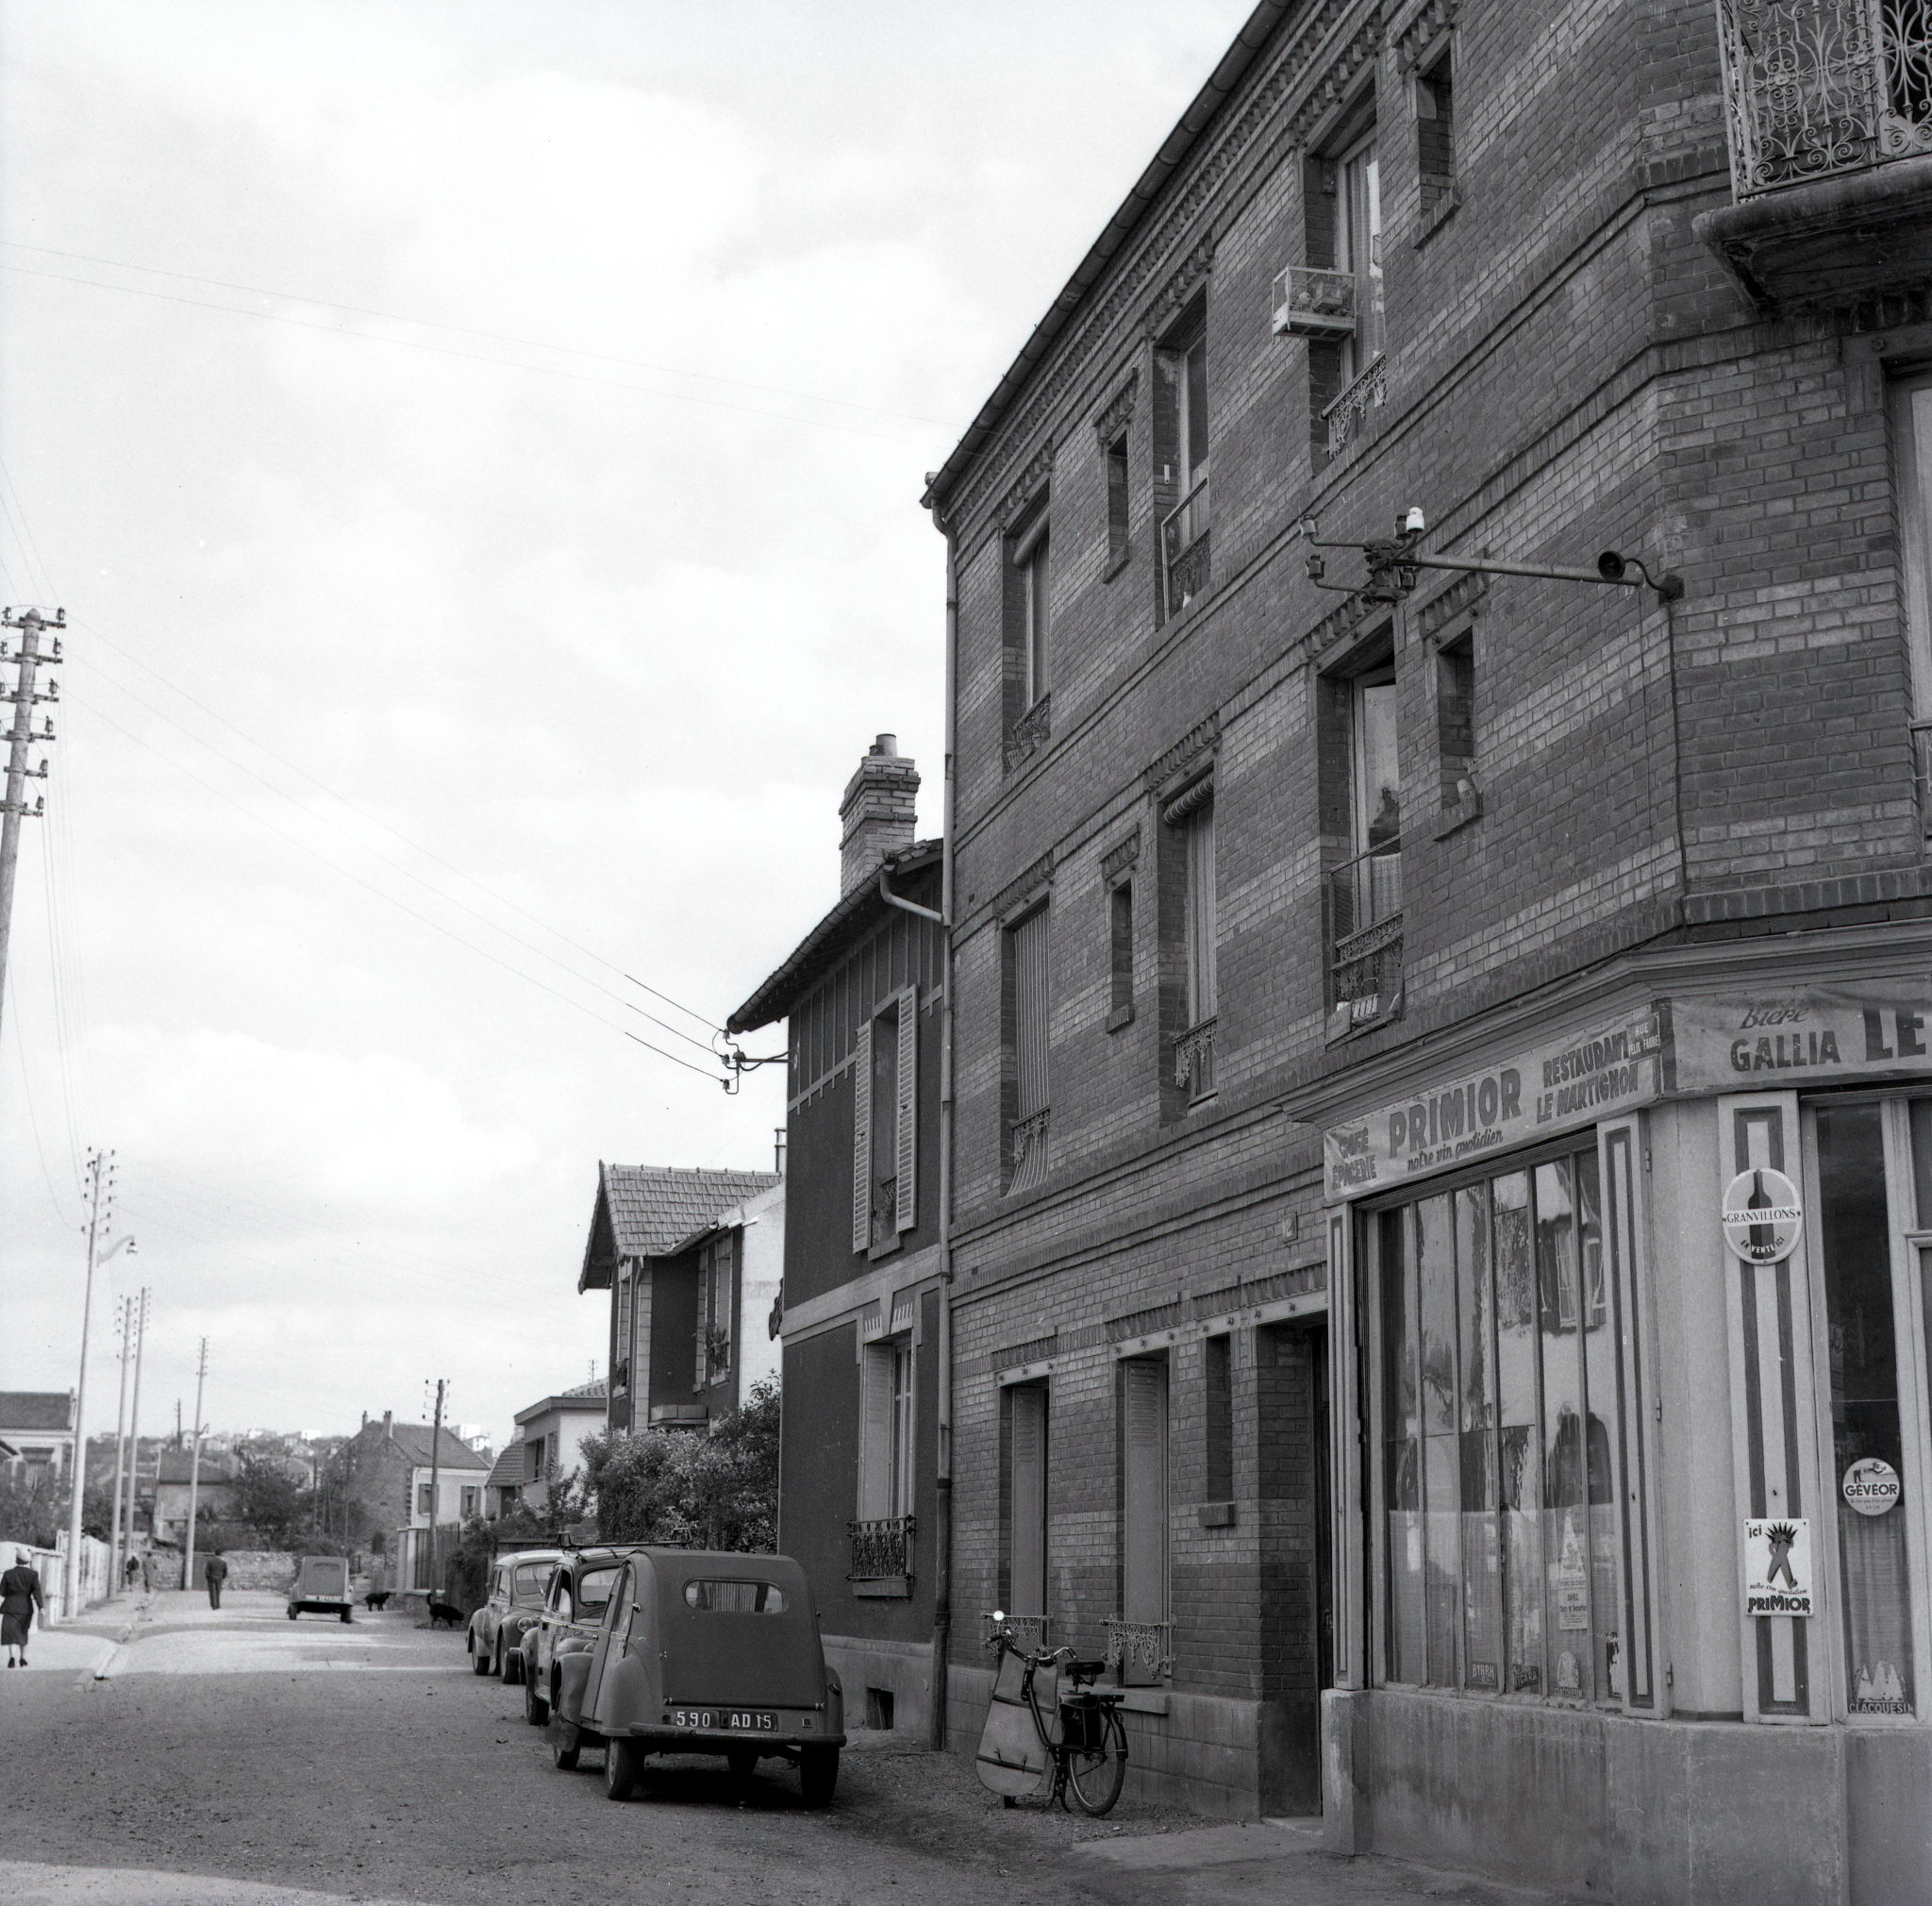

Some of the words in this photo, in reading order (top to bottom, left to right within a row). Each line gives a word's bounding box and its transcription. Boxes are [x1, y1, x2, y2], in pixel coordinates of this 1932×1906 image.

[1635, 1022, 1649, 1038] RUE
[1863, 999, 1926, 1062] LE
[1543, 1030, 1628, 1089] RESTAURANT
[1730, 1030, 1841, 1072] GALLIA
[1537, 1084, 1553, 1125] LE
[1557, 1062, 1639, 1117] MARTIGNON
[1389, 1068, 1522, 1159] PRIMIOR
[1407, 1150, 1434, 1172] notre
[1436, 1143, 1452, 1162] vin
[1455, 1129, 1504, 1160] quotidien
[1740, 1239, 1751, 1249] EN
[1751, 1244, 1775, 1254] VENTE
[1774, 1236, 1785, 1246] ICI
[1749, 1524, 1762, 1539] ici
[1472, 1664, 1494, 1680] BYRRH
[676, 1711, 710, 1728] 590
[731, 1714, 751, 1728] AD
[756, 1714, 772, 1729] 15
[1848, 1702, 1914, 1714] CLACQUESIN
